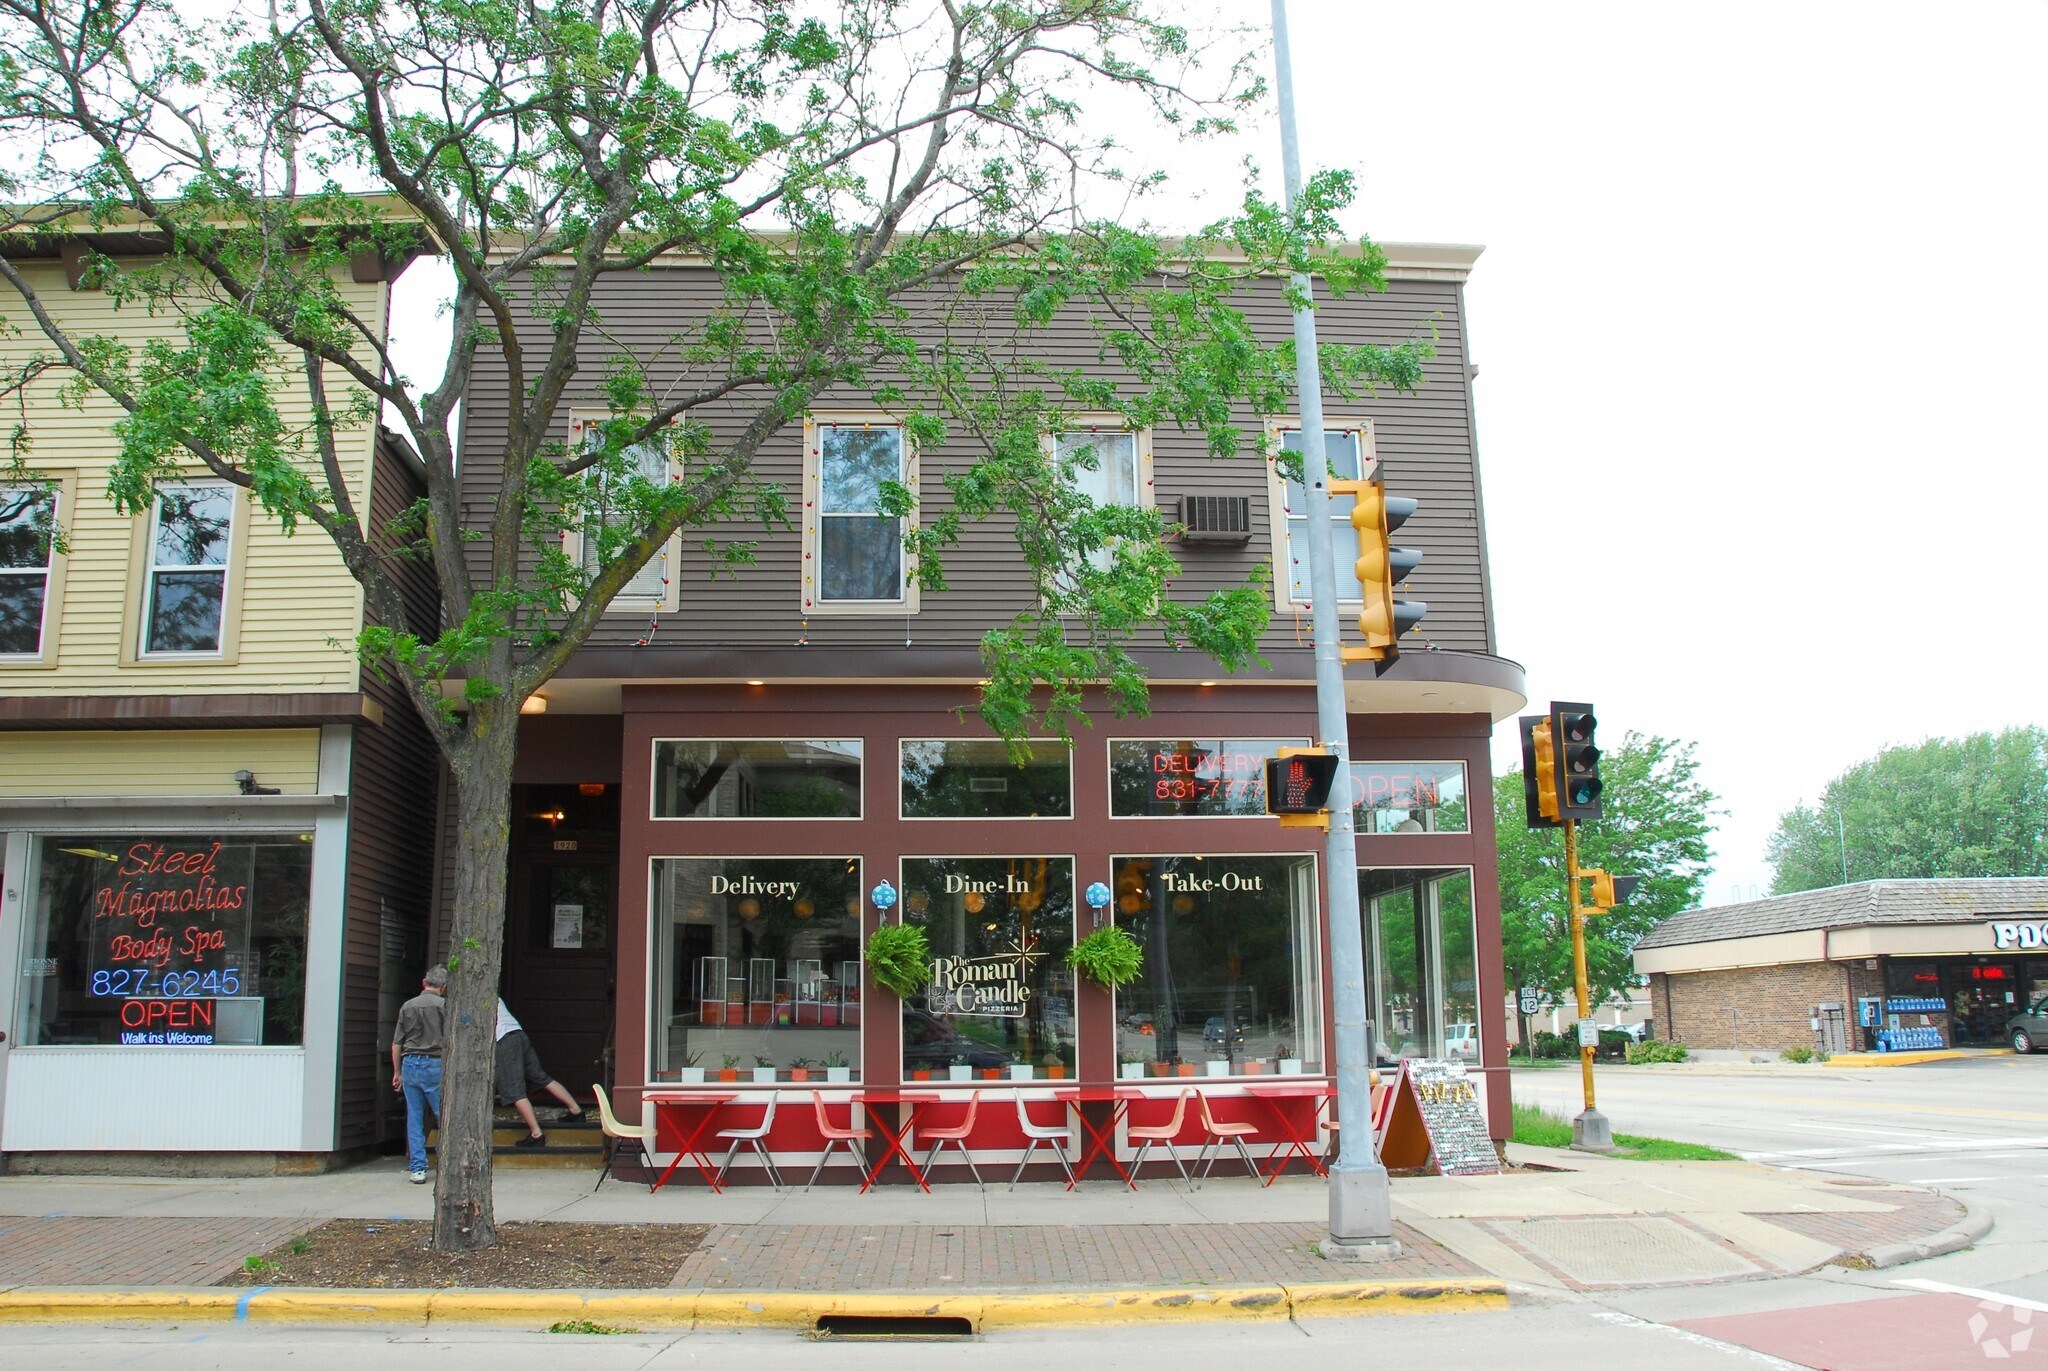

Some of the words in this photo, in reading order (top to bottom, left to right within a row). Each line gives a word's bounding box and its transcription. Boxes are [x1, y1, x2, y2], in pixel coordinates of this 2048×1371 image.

[1154, 753, 1263, 773] DELIVERY
[1156, 779, 1264, 799] 831-7777
[555, 841, 577, 849] 1920
[118, 842, 222, 876] Steel
[710, 875, 800, 900] Delivery
[945, 874, 1030, 895] Dine-In
[1165, 872, 1264, 893] Take-Out
[96, 875, 247, 928] Magnolias
[111, 927, 173, 967] Body
[180, 926, 226, 962] Spa
[1992, 922, 2048, 949] PD
[951, 955, 970, 966] The
[91, 968, 240, 998] 827-6245
[934, 958, 1016, 991] Roman
[956, 979, 1031, 1012] Candle
[1522, 988, 1535, 996] JCT
[121, 1000, 212, 1027] OPEN
[1525, 1000, 1536, 1010] 12
[121, 1032, 147, 1045] Walk
[149, 1032, 164, 1044] ins
[166, 1032, 213, 1044] Welcome
[1418, 1082, 1476, 1105] PIZZA
